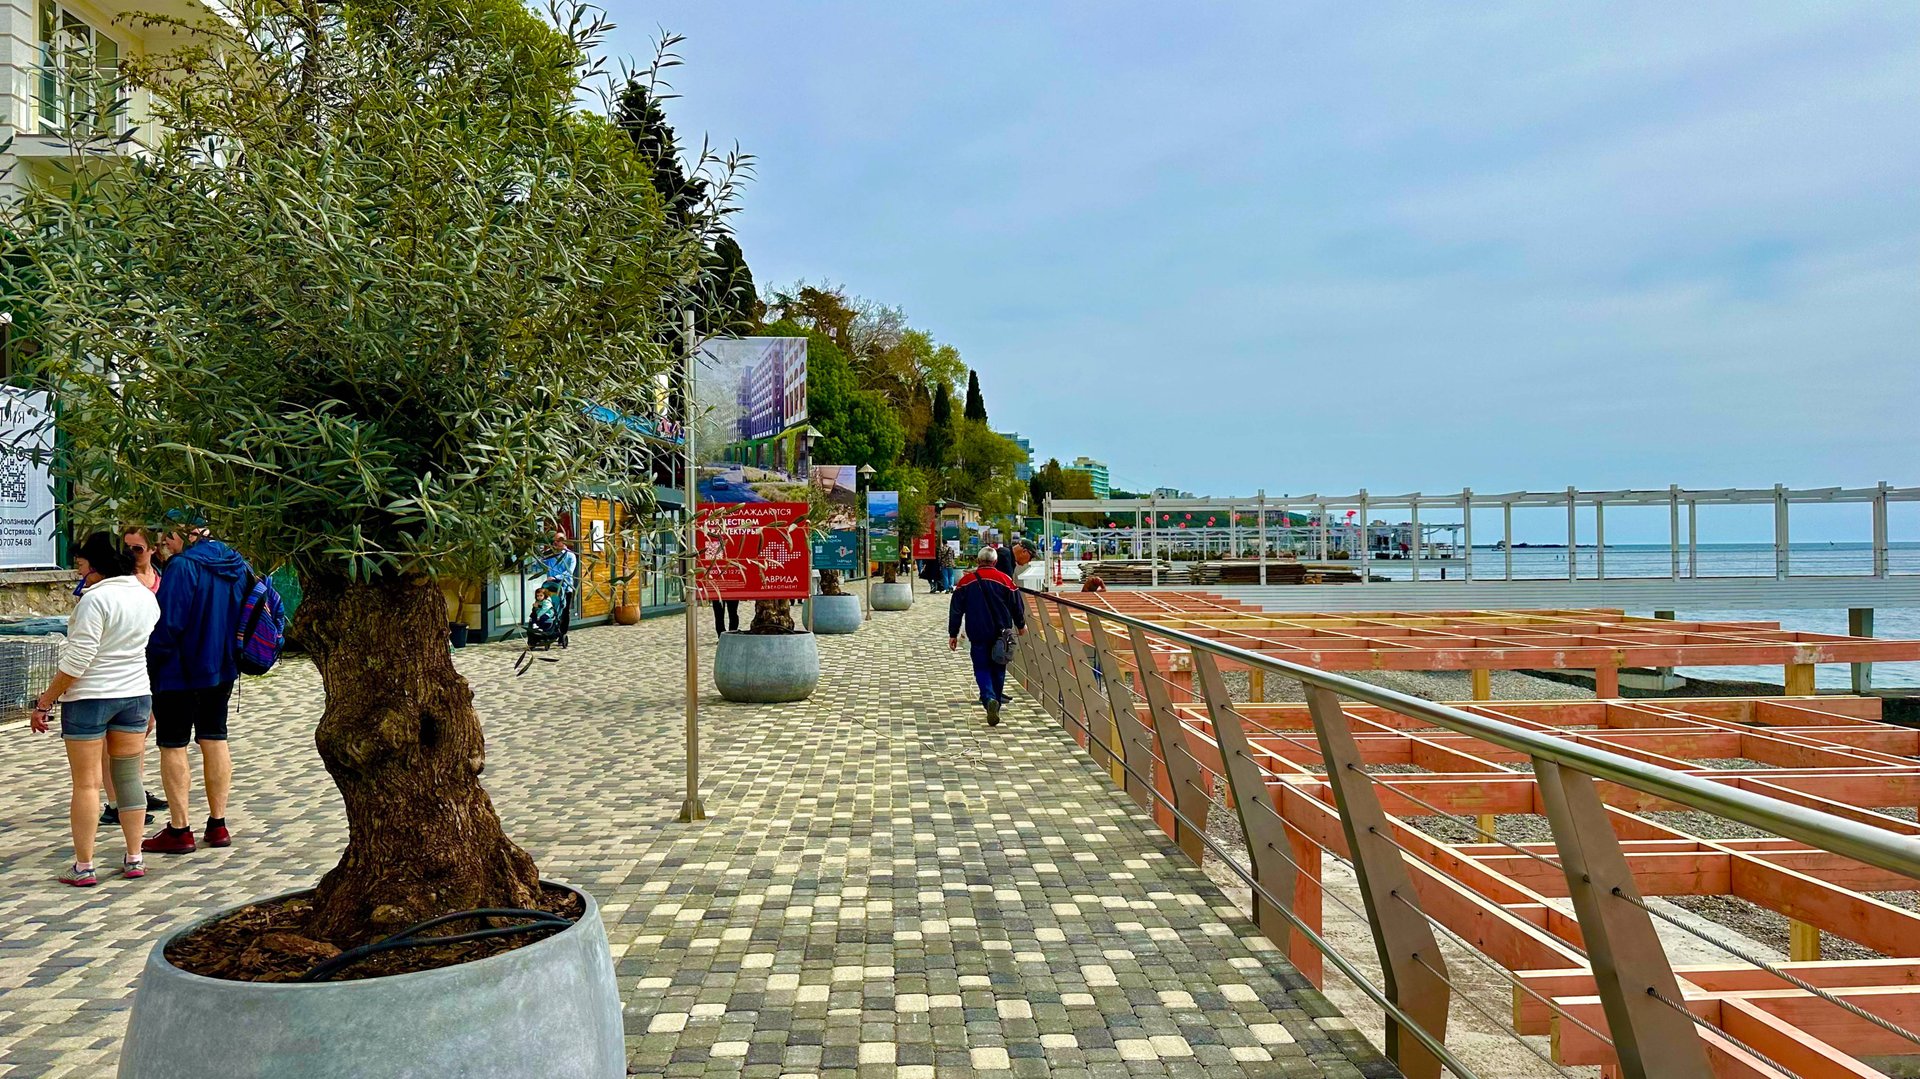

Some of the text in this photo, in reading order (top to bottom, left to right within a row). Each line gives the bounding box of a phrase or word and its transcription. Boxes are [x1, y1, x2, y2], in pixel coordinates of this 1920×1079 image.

[38, 528, 42, 536] 9
[3, 538, 14, 546] 707
[15, 538, 23, 546] 54
[24, 538, 32, 546] 68
[761, 575, 799, 583] АВРИДА
